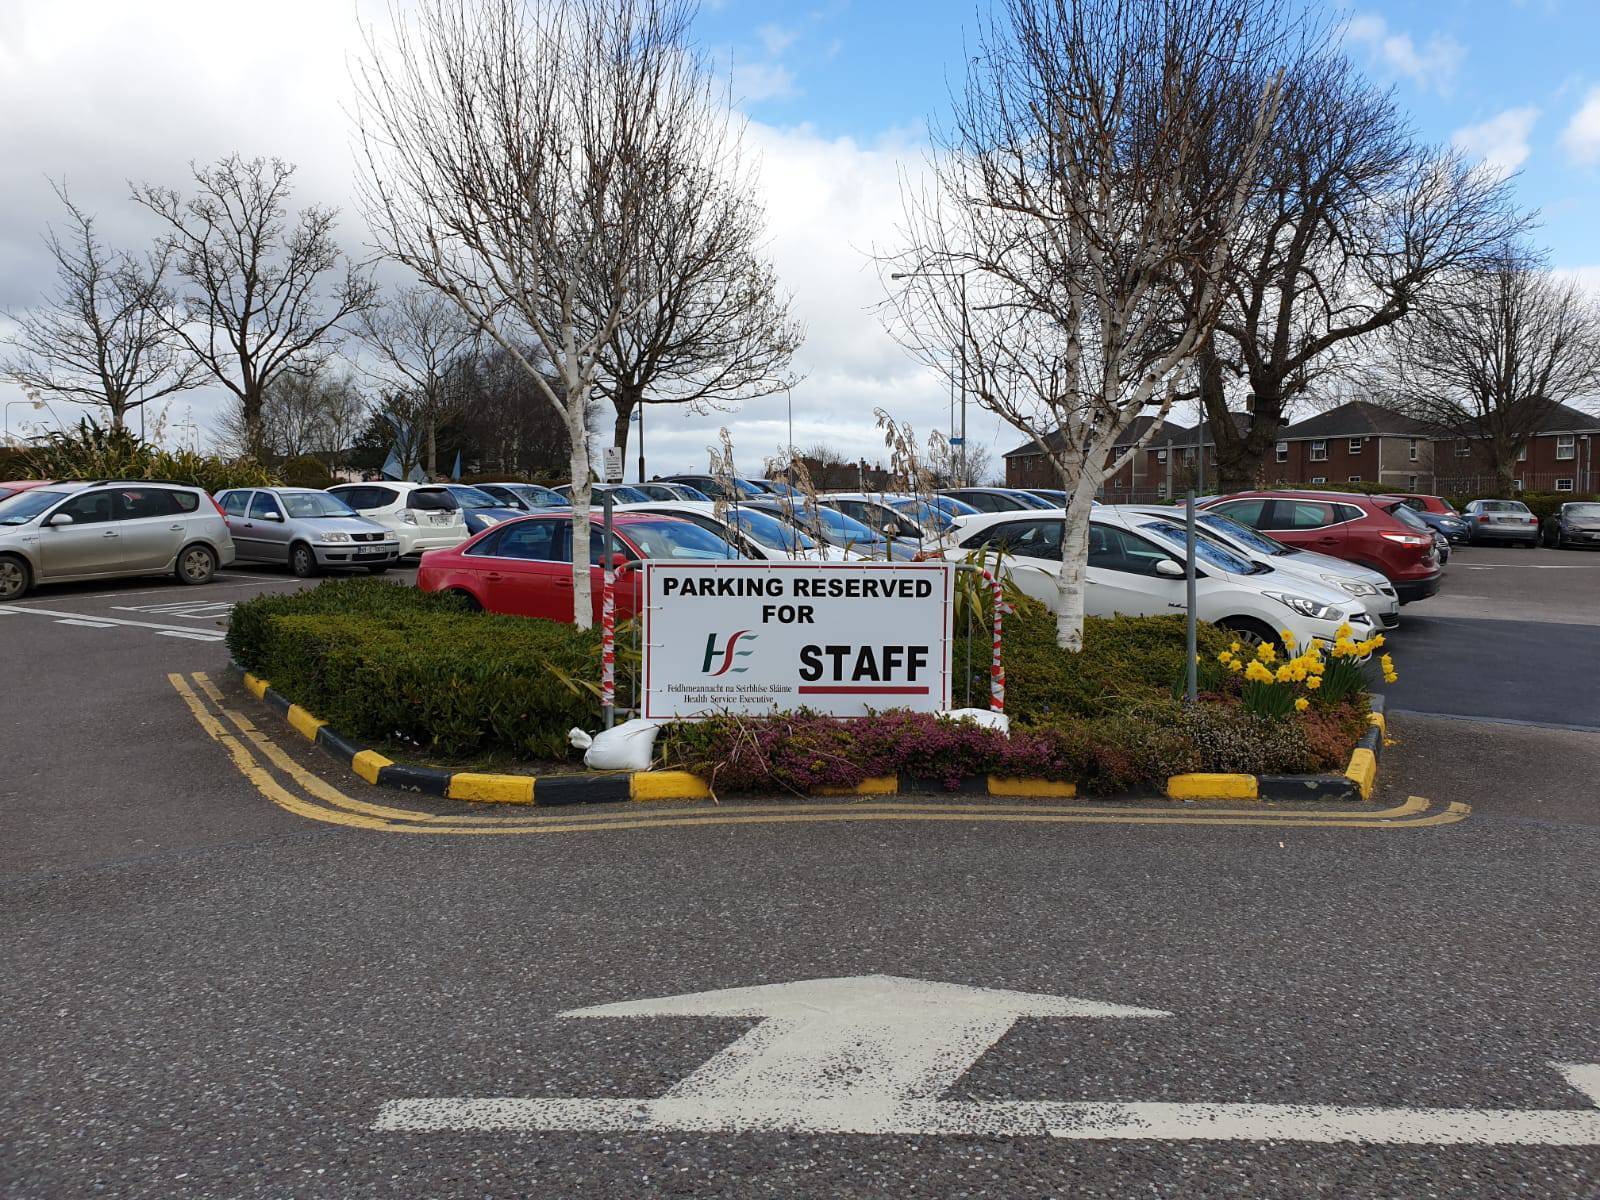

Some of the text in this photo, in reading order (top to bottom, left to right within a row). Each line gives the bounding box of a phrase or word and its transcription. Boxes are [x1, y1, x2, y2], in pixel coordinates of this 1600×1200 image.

[664, 578, 932, 598] PARKING RESERVED
[763, 605, 814, 623] FOR
[799, 645, 928, 681] STAFF
[725, 685, 735, 693] na
[684, 694, 774, 703] Health Service Executive
